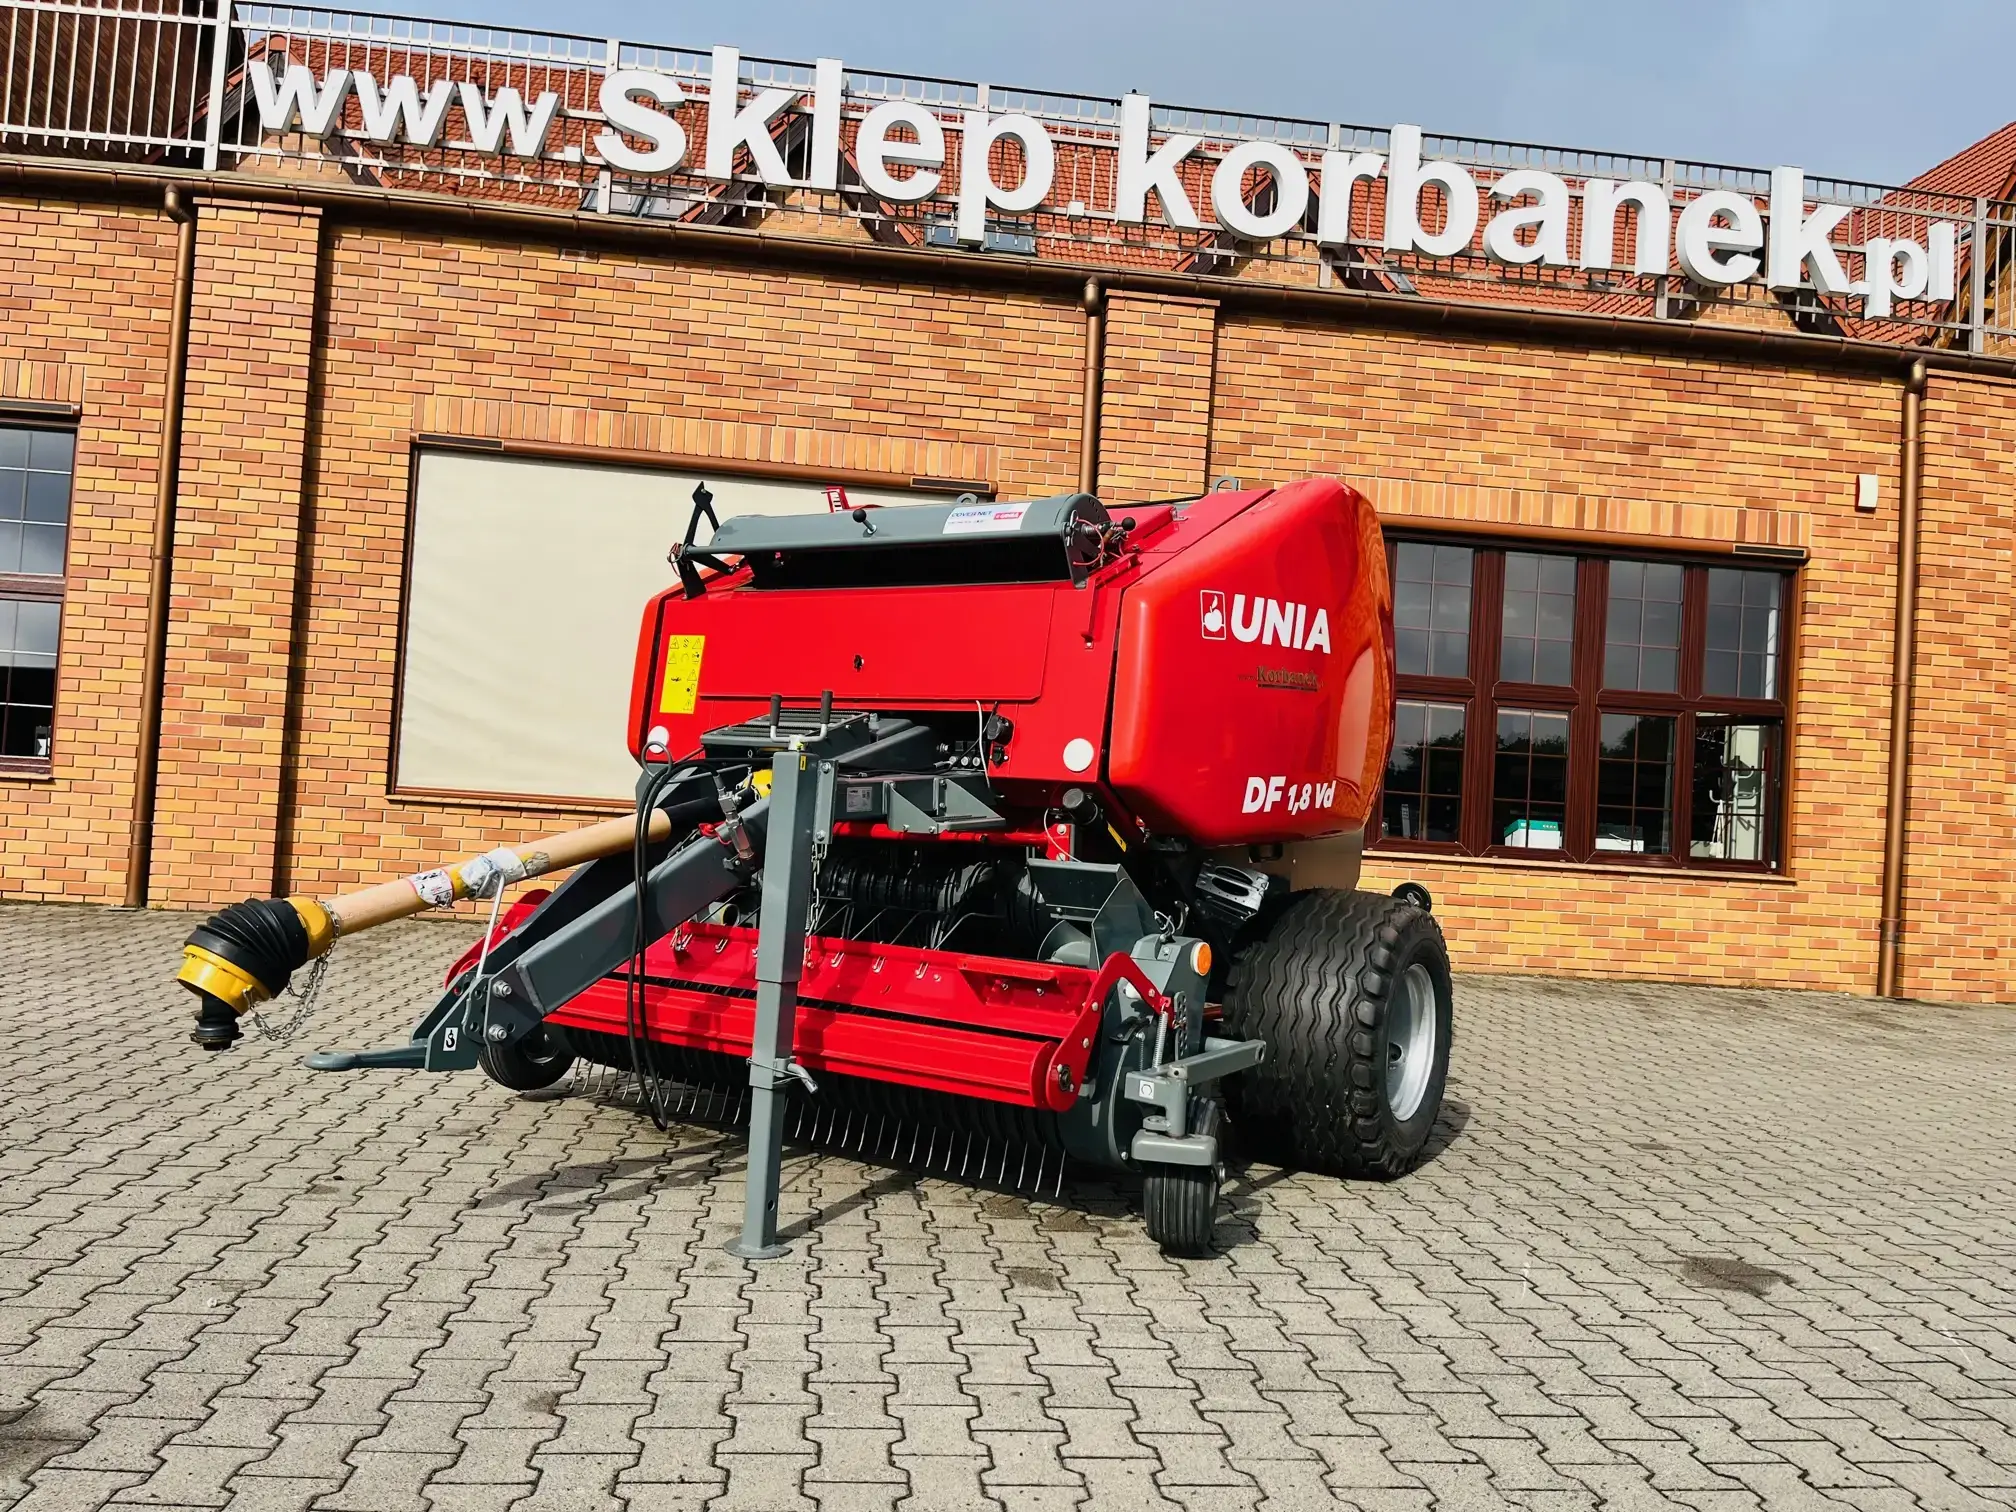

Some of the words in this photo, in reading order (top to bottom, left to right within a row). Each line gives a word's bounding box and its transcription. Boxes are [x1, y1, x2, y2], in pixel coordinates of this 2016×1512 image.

[249, 46, 1956, 320] www.sklep.korbanek.pl
[1231, 594, 1331, 654] UNIA
[1242, 776, 1286, 813] DF
[1288, 783, 1312, 815] 1,8
[1315, 780, 1337, 808] Vd
